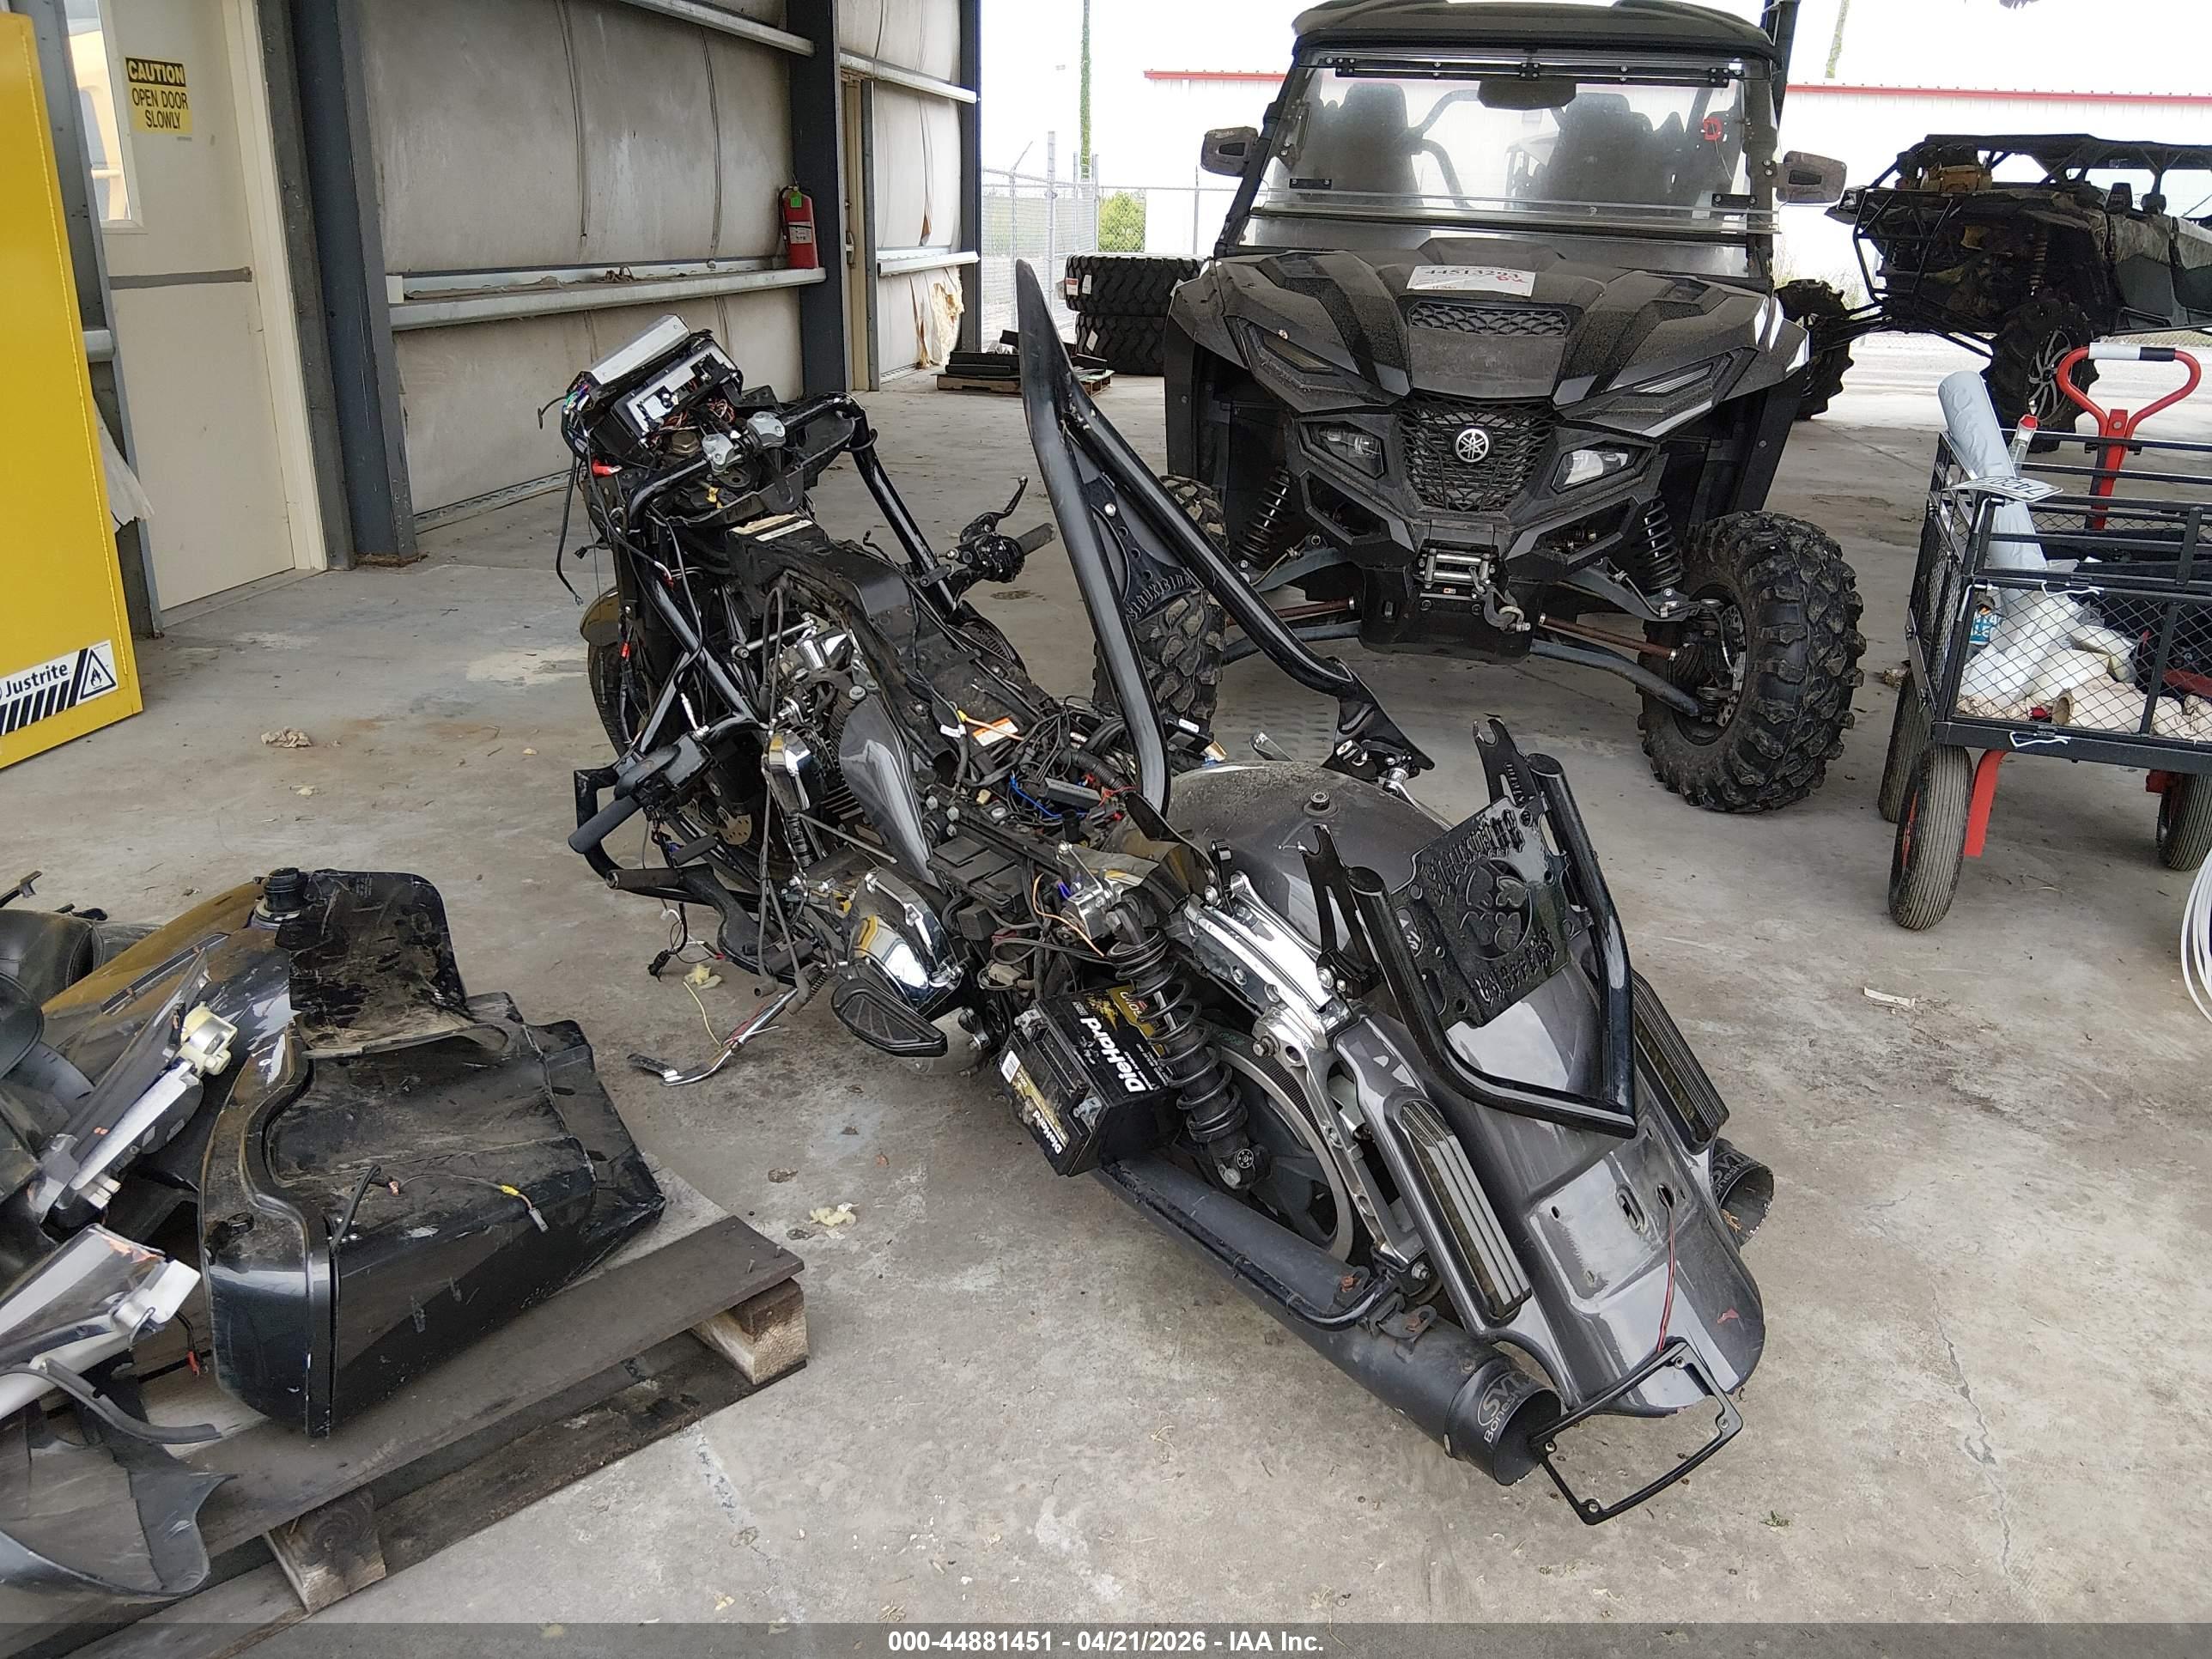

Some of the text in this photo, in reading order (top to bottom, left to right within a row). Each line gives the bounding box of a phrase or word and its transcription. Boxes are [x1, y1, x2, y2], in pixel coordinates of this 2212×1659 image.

[127, 60, 185, 84] CAUTION
[131, 88, 189, 110] OPEN DOOR
[144, 109, 180, 129] SLOWLY
[5, 663, 69, 698] Justrite
[1079, 1018, 1146, 1092] DieHard
[1017, 1072, 1028, 1087] GOLD
[1033, 1109, 1063, 1155] DieHard
